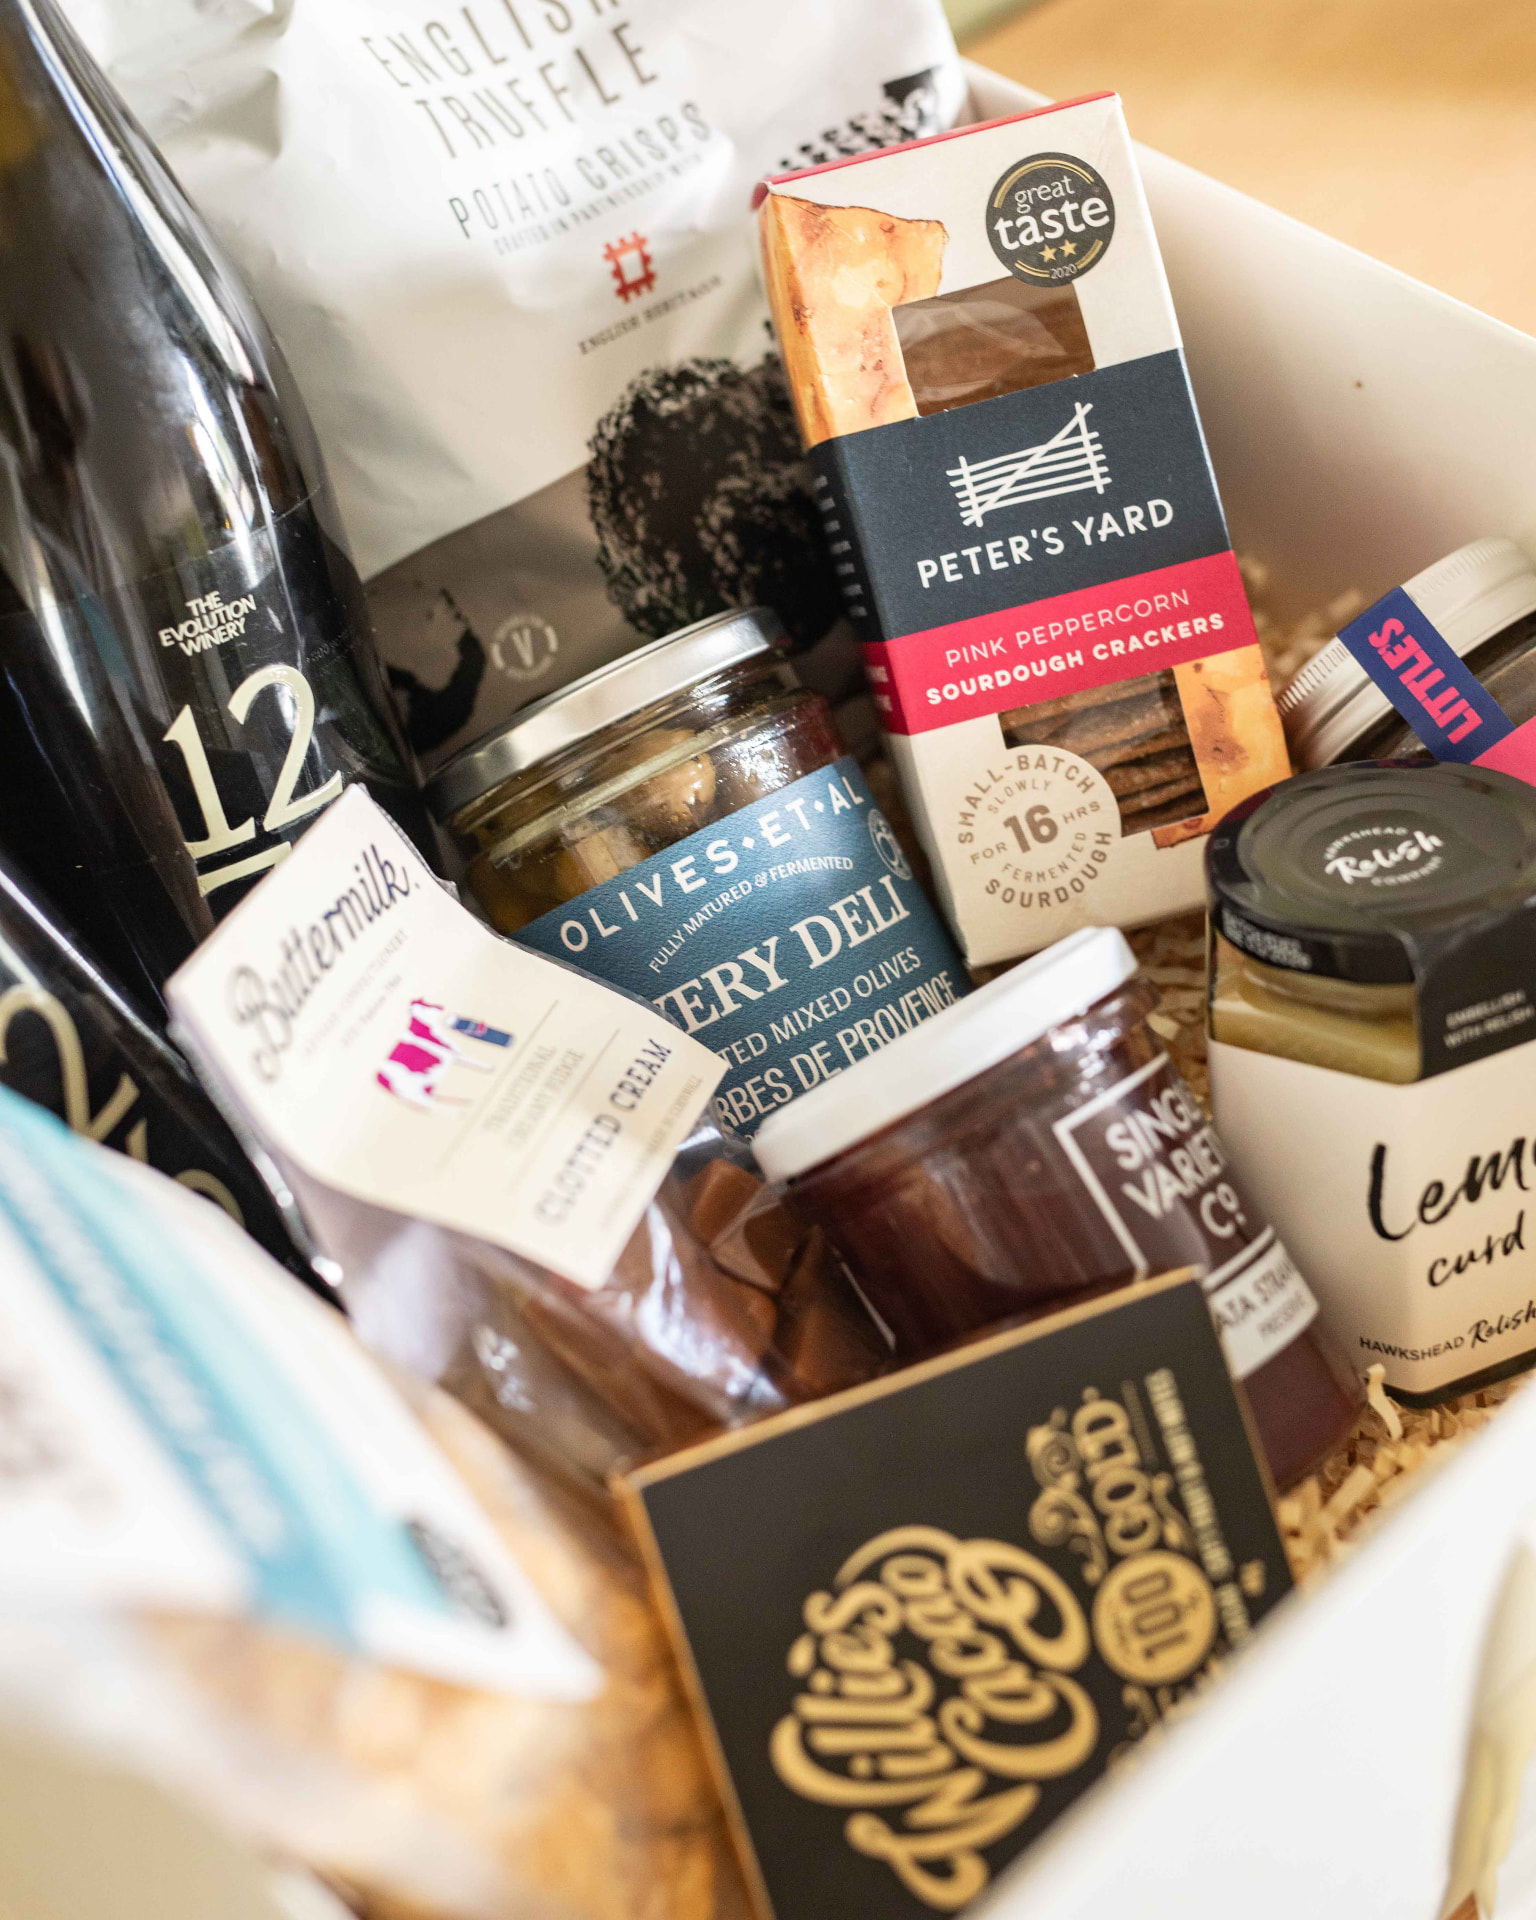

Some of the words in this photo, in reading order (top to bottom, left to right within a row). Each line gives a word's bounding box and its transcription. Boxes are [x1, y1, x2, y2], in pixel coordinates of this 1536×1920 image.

[361, 0, 619, 87] ENGLIS
[415, 20, 658, 159] TRUFFLE
[449, 168, 571, 239] POTATO
[575, 100, 711, 190] CRISPS
[1014, 175, 1076, 214] great
[993, 197, 1110, 251] taste
[1049, 263, 1078, 279] 2020
[916, 525, 1065, 588] PETER'S
[1072, 498, 1175, 547] YARD
[158, 594, 257, 648] EVOLUTION
[179, 617, 248, 657] WINERY
[186, 591, 224, 617] THE
[945, 636, 1008, 668] PINK
[1016, 588, 1190, 649] PEPPERCORN
[926, 649, 1084, 706] SOURDOUGH
[1092, 612, 1225, 661] CRACKERS
[163, 664, 344, 861] 12
[987, 778, 1052, 814] SLOWLY
[970, 841, 1009, 865] FOR
[1003, 804, 1058, 854] 16
[1062, 801, 1101, 824] HRS
[985, 831, 1112, 908] SOURDOUGH
[1002, 832, 1087, 883] FERMENTED
[1324, 830, 1444, 885] Relish
[648, 930, 687, 975] FULLY
[683, 879, 753, 935] MATURED
[768, 855, 854, 883] FERMENTED
[789, 874, 911, 970] DELI
[769, 987, 852, 1044] MIXED
[854, 946, 921, 998] OLIVES
[790, 1040, 843, 1091] DE
[836, 970, 959, 1067] PROVENCE
[608, 1037, 673, 1113] CREAM
[1366, 1136, 1536, 1242] Lem
[1427, 1209, 1526, 1288] curd
[1359, 1334, 1465, 1362] HAWKSHEAD
[1467, 1299, 1536, 1349] Relish
[1072, 1398, 1163, 1556] GOLD
[1120, 1566, 1189, 1660] 100
